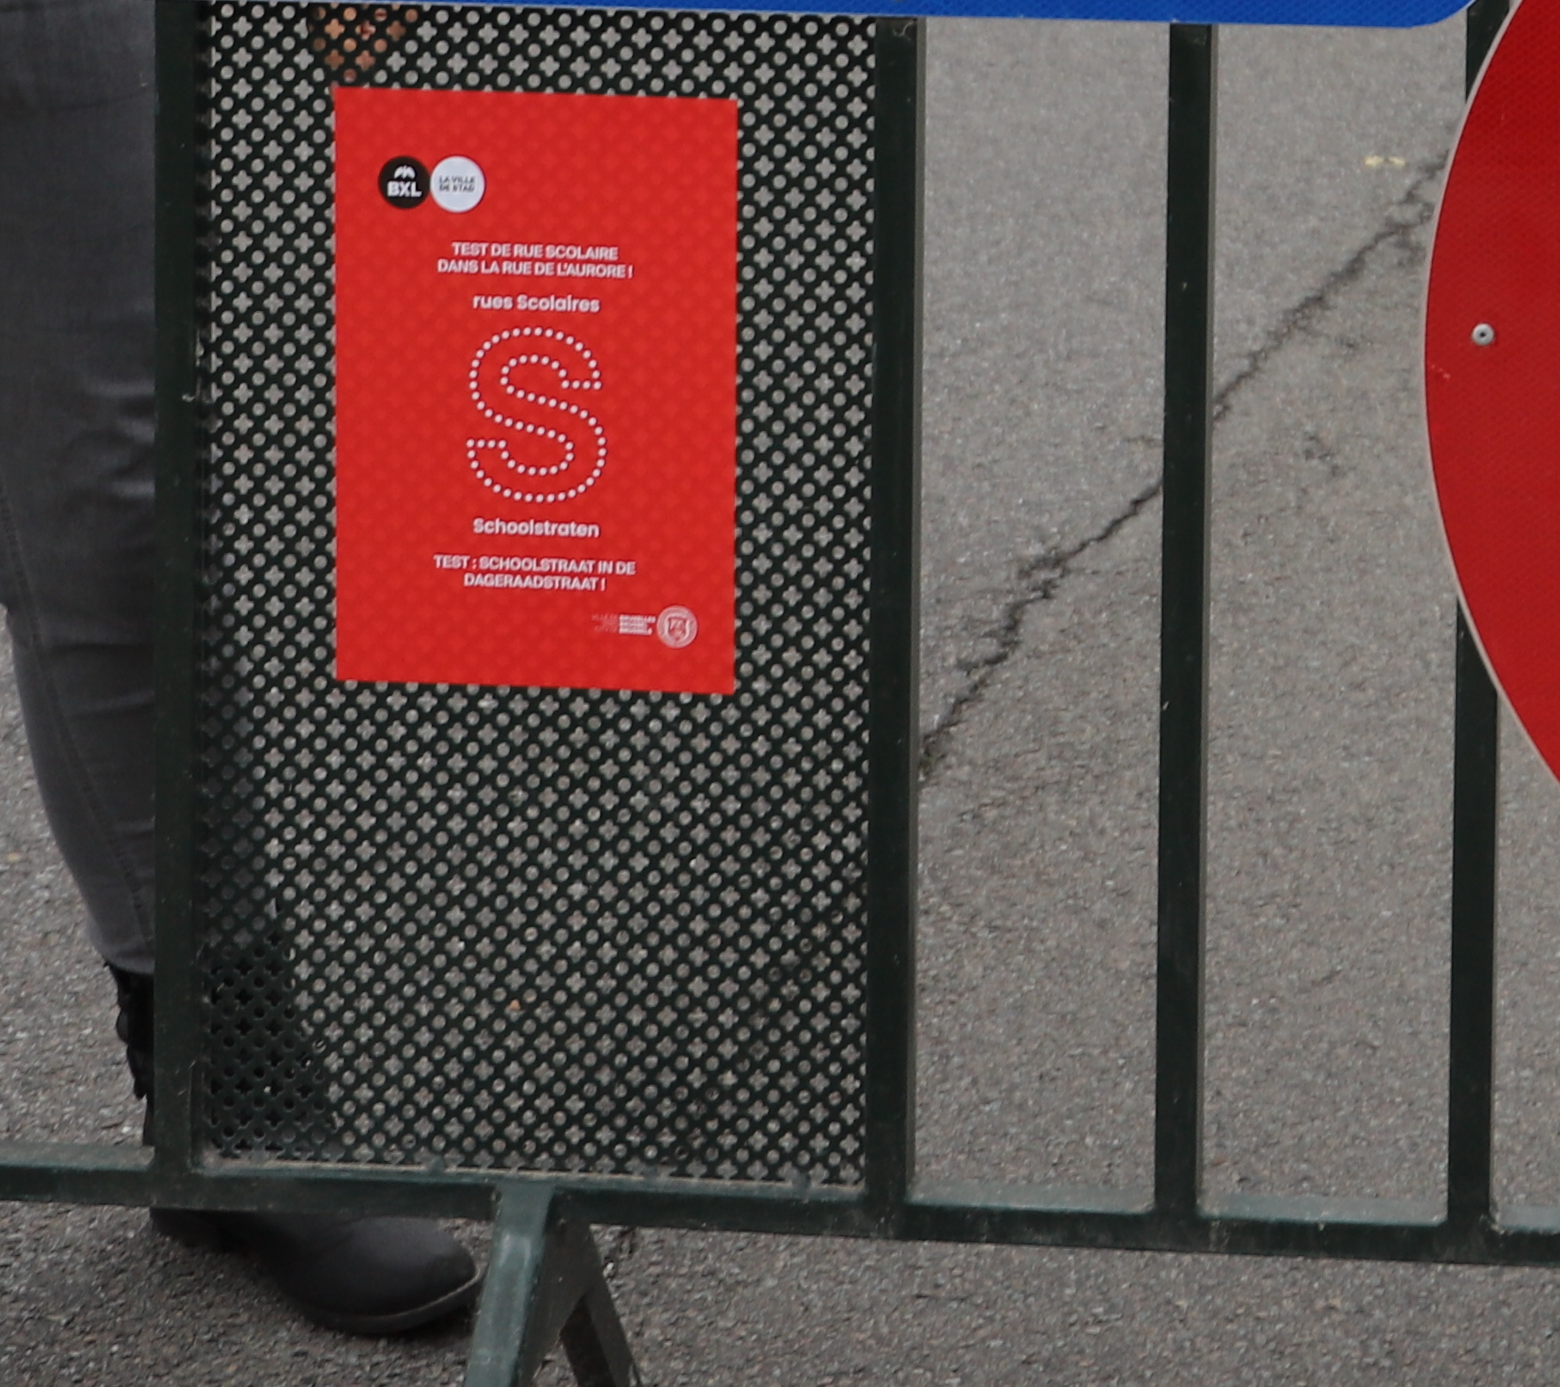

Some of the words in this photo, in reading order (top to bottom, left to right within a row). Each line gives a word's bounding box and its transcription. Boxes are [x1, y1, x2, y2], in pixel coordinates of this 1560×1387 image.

[387, 181, 422, 197] BXL
[452, 242, 489, 257] TEST
[491, 243, 511, 257] DE
[513, 244, 543, 259] RUE
[545, 245, 619, 261] SCOLAIRE
[437, 259, 479, 274] DANS
[481, 260, 499, 274] LA
[502, 262, 532, 275] RUE
[535, 262, 554, 276] DE
[473, 295, 513, 310] rues
[516, 294, 601, 313] Scolaires
[466, 327, 608, 503] S
[473, 517, 600, 538] Schoolstraten
[433, 554, 471, 569] TEST
[479, 556, 596, 573] SCHOOLSTRAAT
[598, 560, 613, 574] IN
[616, 561, 636, 575] DE
[464, 573, 599, 591] DAGERAADSTRAAT
